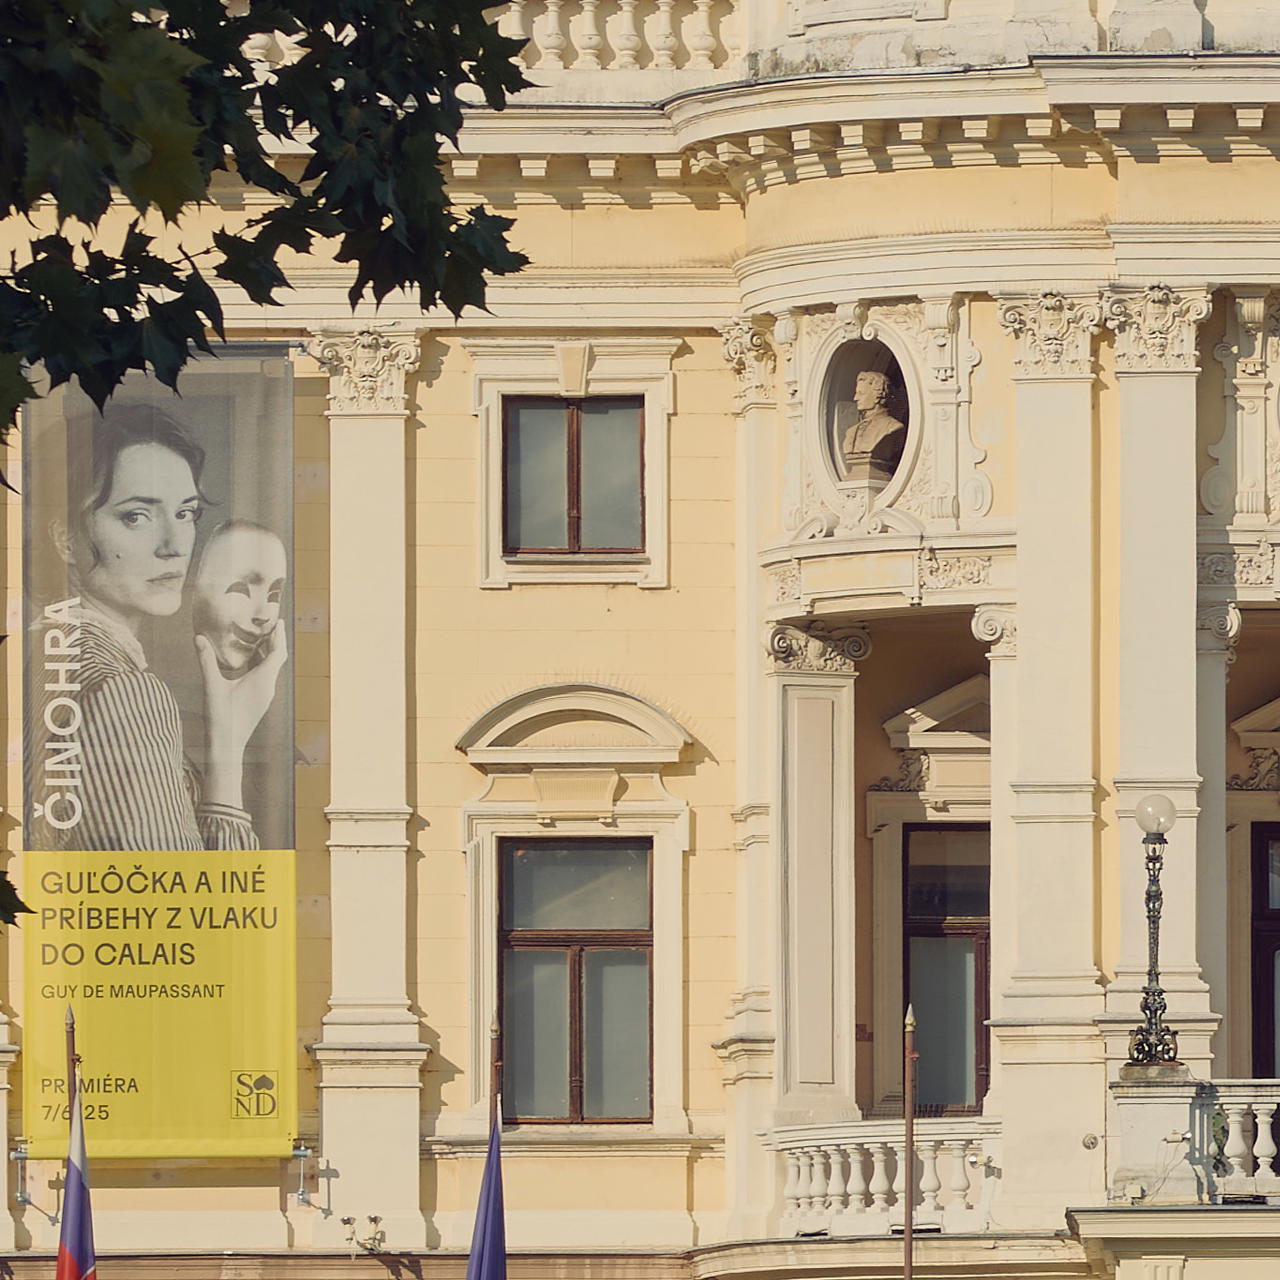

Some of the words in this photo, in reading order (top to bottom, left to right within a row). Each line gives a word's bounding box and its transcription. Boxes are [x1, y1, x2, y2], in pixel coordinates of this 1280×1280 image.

[33, 596, 82, 830] ČINOHRA
[41, 865, 187, 894] GUĽÔČKA
[195, 871, 212, 893] A
[222, 865, 265, 893] INÉ
[41, 901, 158, 929] PRÍBEHY
[166, 907, 182, 929] Z
[189, 907, 278, 929] VLAKU
[41, 943, 85, 966] DO
[95, 942, 196, 965] CALAIS
[41, 984, 78, 999] GUY
[83, 984, 104, 998] DE
[110, 984, 225, 999] MAUPASSANT
[41, 1073, 139, 1094] PRMIÉRA
[41, 1103, 110, 1122] 7/625
